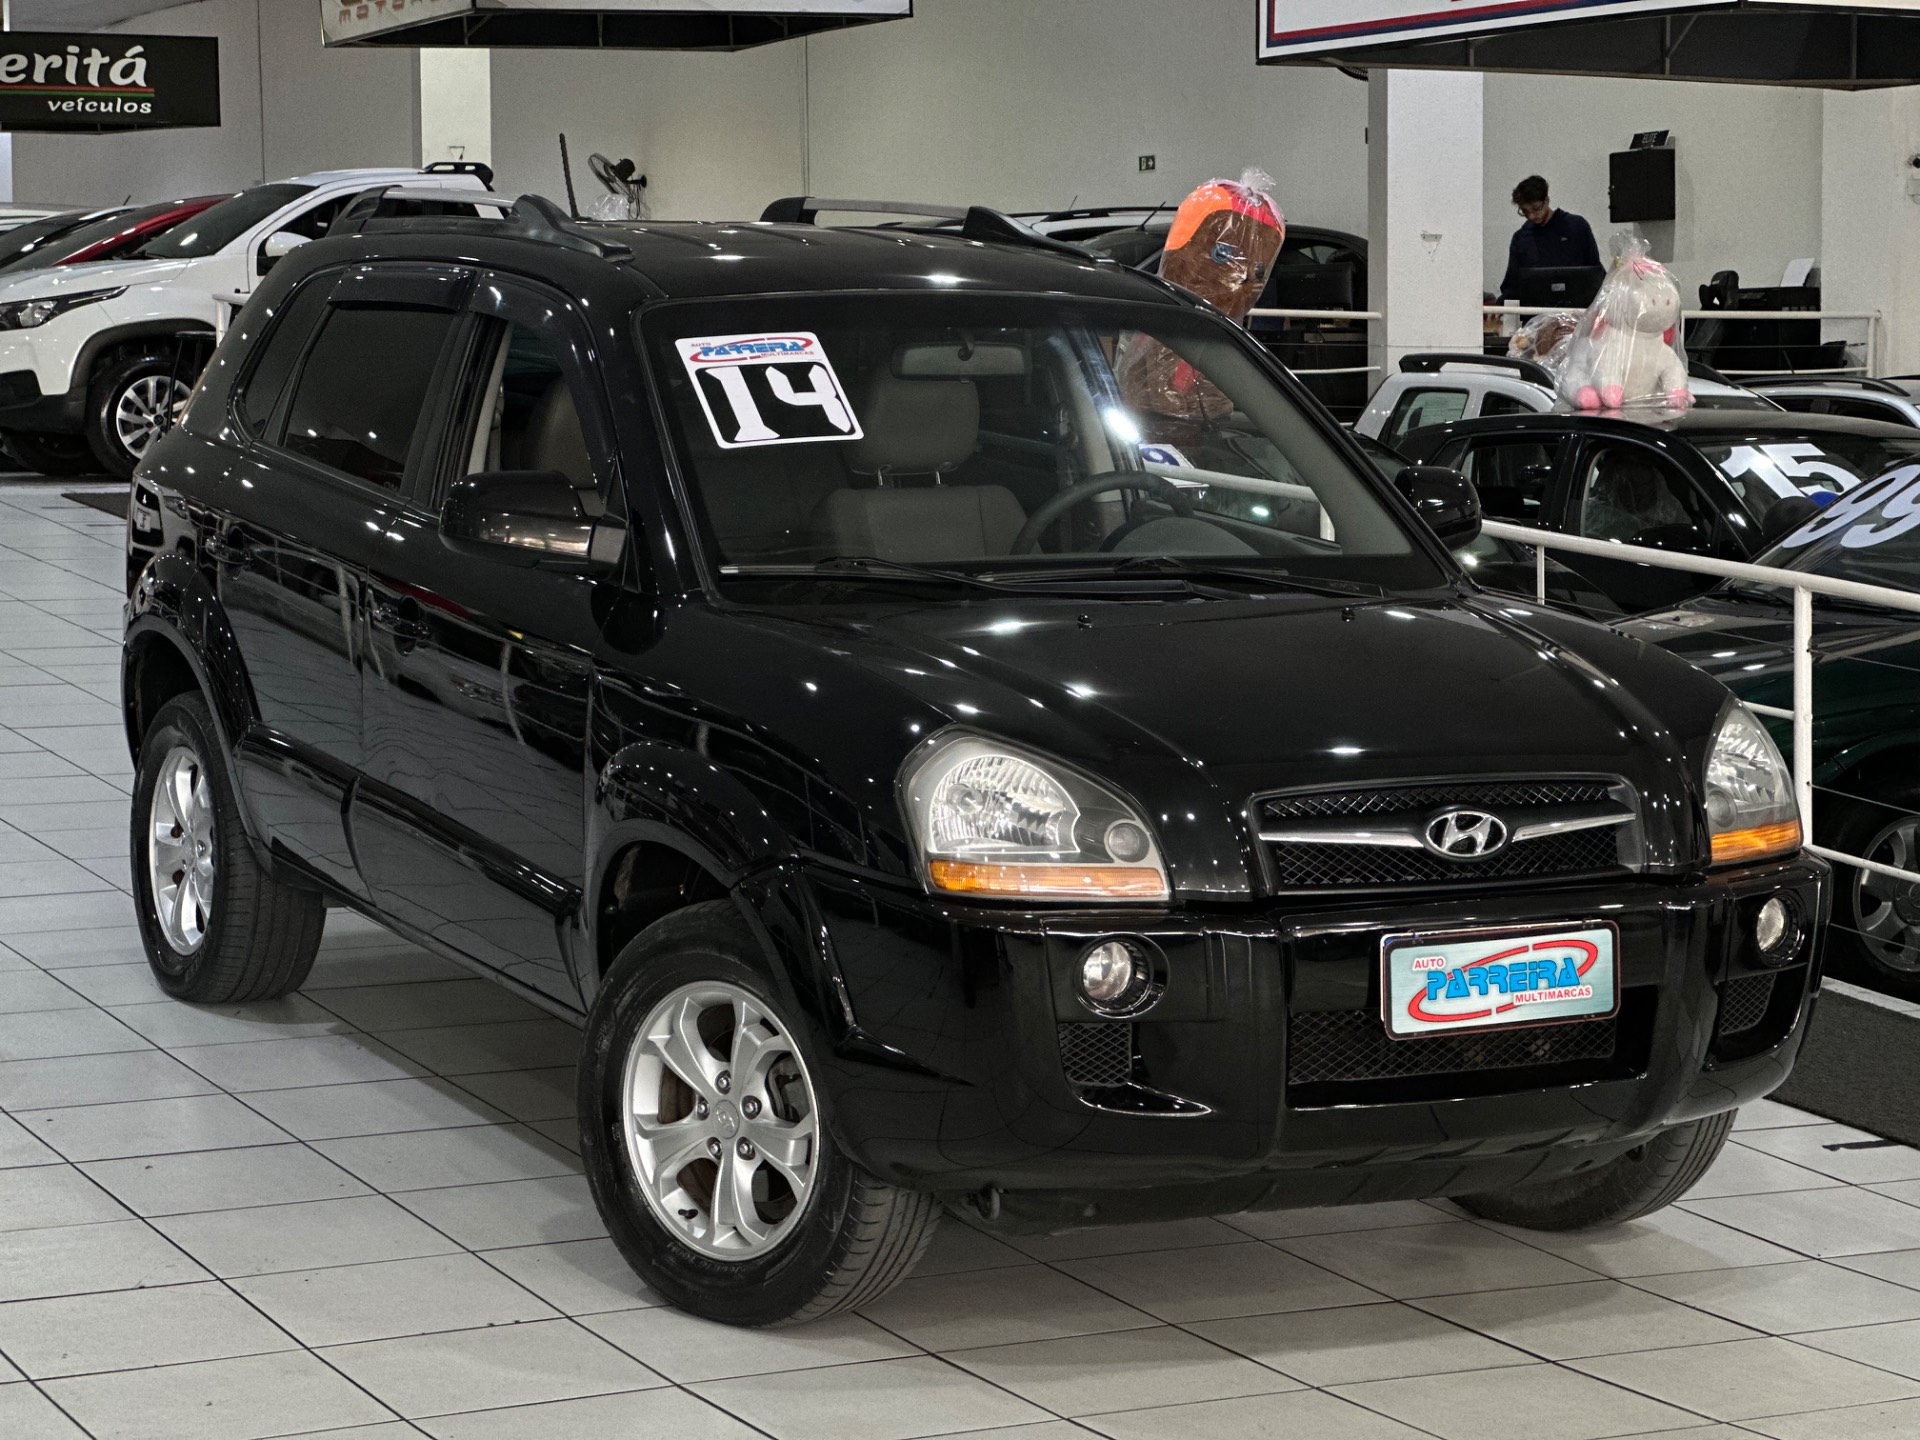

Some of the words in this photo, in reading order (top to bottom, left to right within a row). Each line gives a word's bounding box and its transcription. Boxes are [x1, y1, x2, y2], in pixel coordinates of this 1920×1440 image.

[0, 45, 147, 87] eritá
[48, 97, 152, 114] veículos
[700, 341, 805, 357] PARREIRA
[705, 364, 852, 442] 14
[1719, 443, 1862, 499] 15
[1413, 957, 1445, 970] AUTO
[1427, 957, 1581, 1001] PARREIRA
[1514, 986, 1592, 1004] MULTIMARCAS
